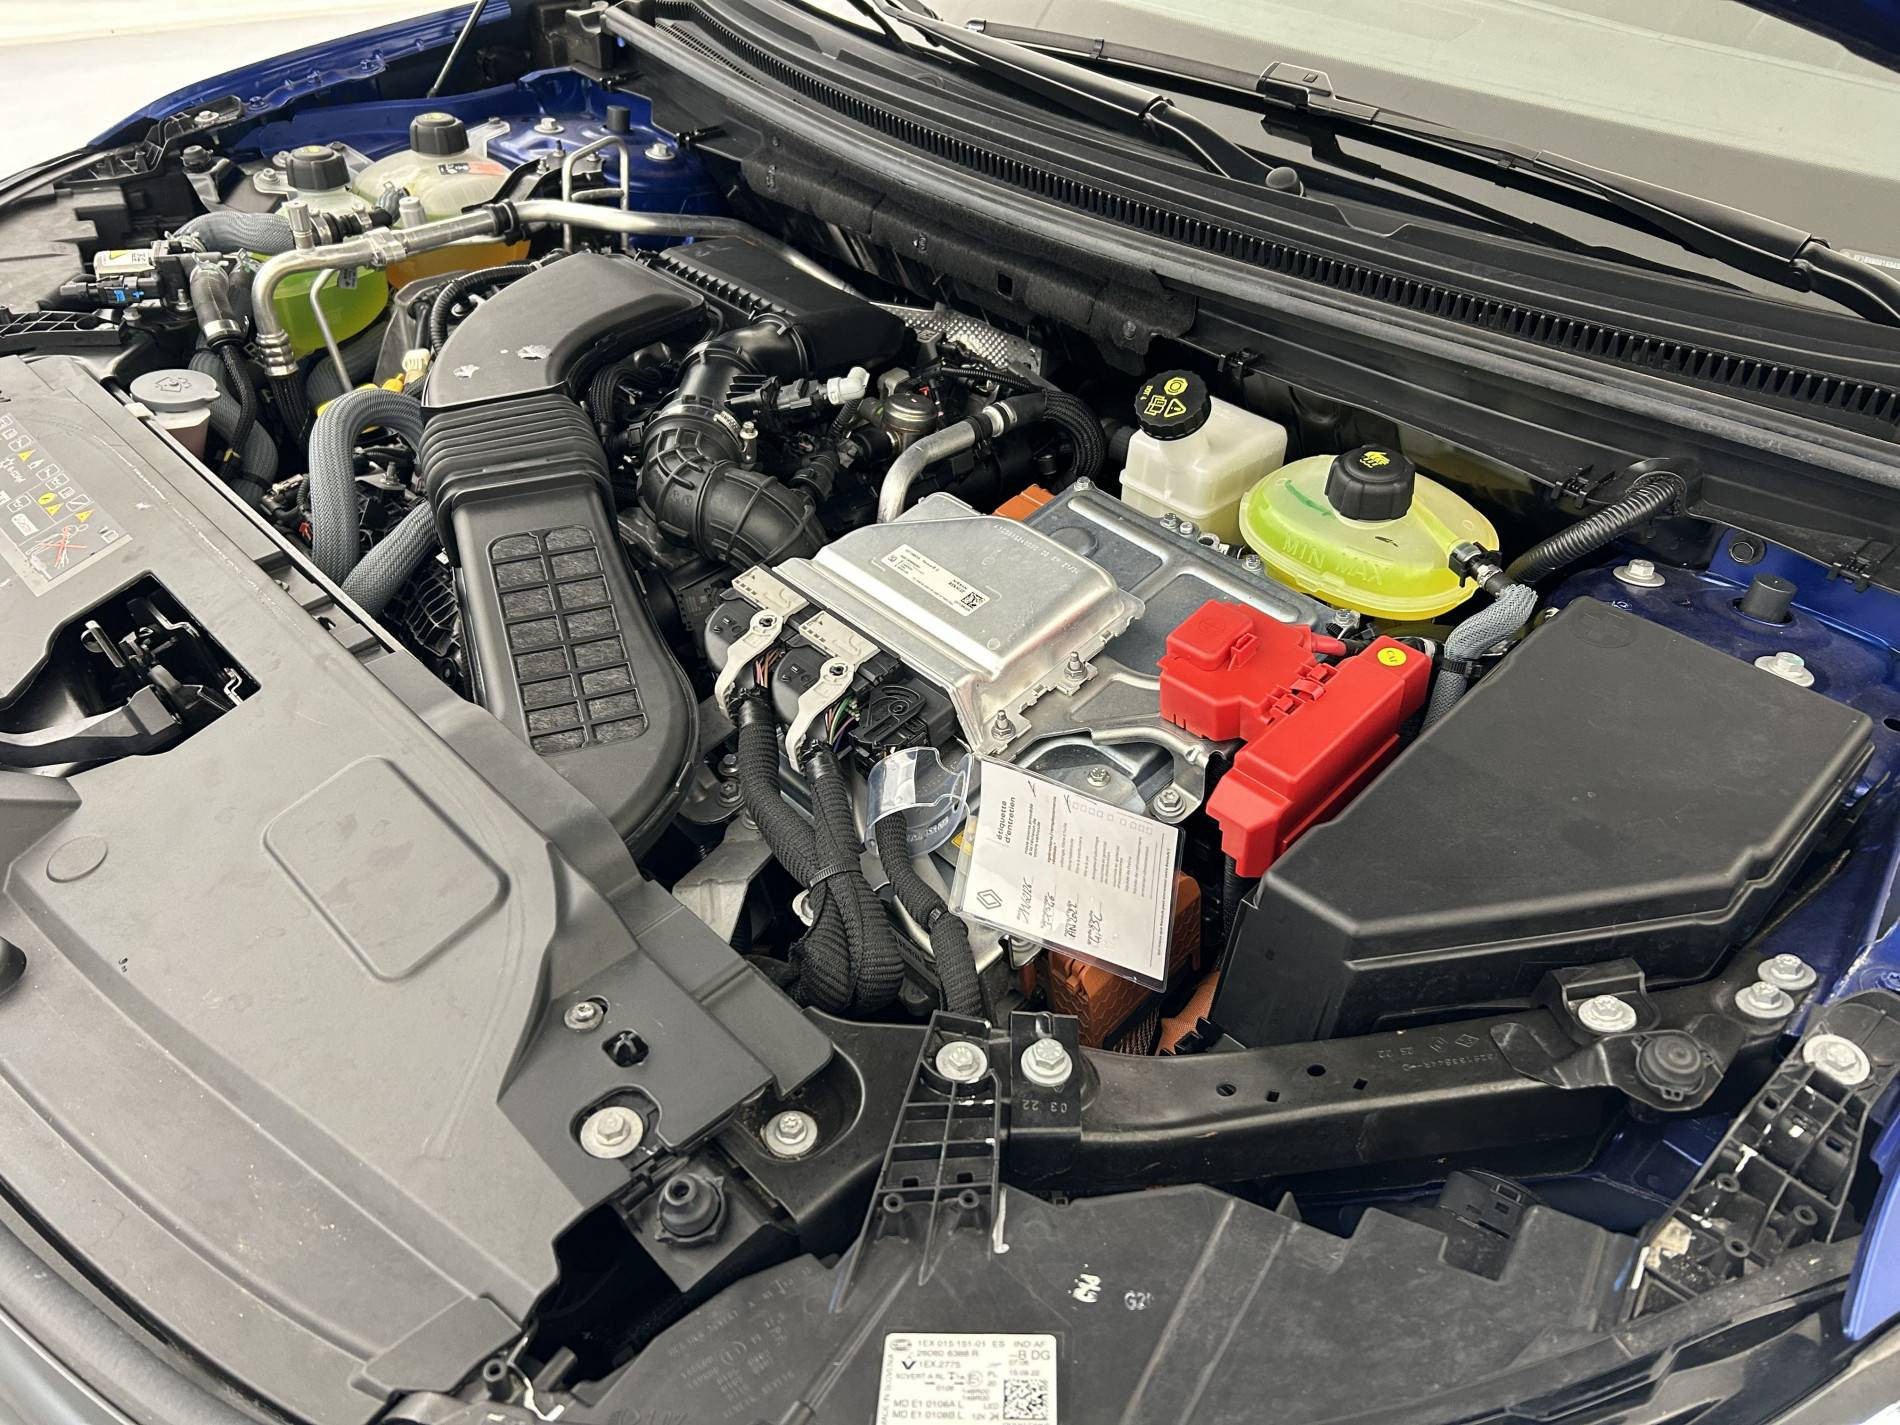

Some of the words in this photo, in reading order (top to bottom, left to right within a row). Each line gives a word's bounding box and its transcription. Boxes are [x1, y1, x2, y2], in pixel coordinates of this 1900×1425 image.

[1283, 535, 1326, 569] MIN
[1335, 554, 1386, 586] MAX
[996, 800, 1007, 841] étiquette
[1021, 1099, 1040, 1111] 22
[918, 1339, 935, 1348] 1EX
[1031, 1349, 1051, 1361] DG
